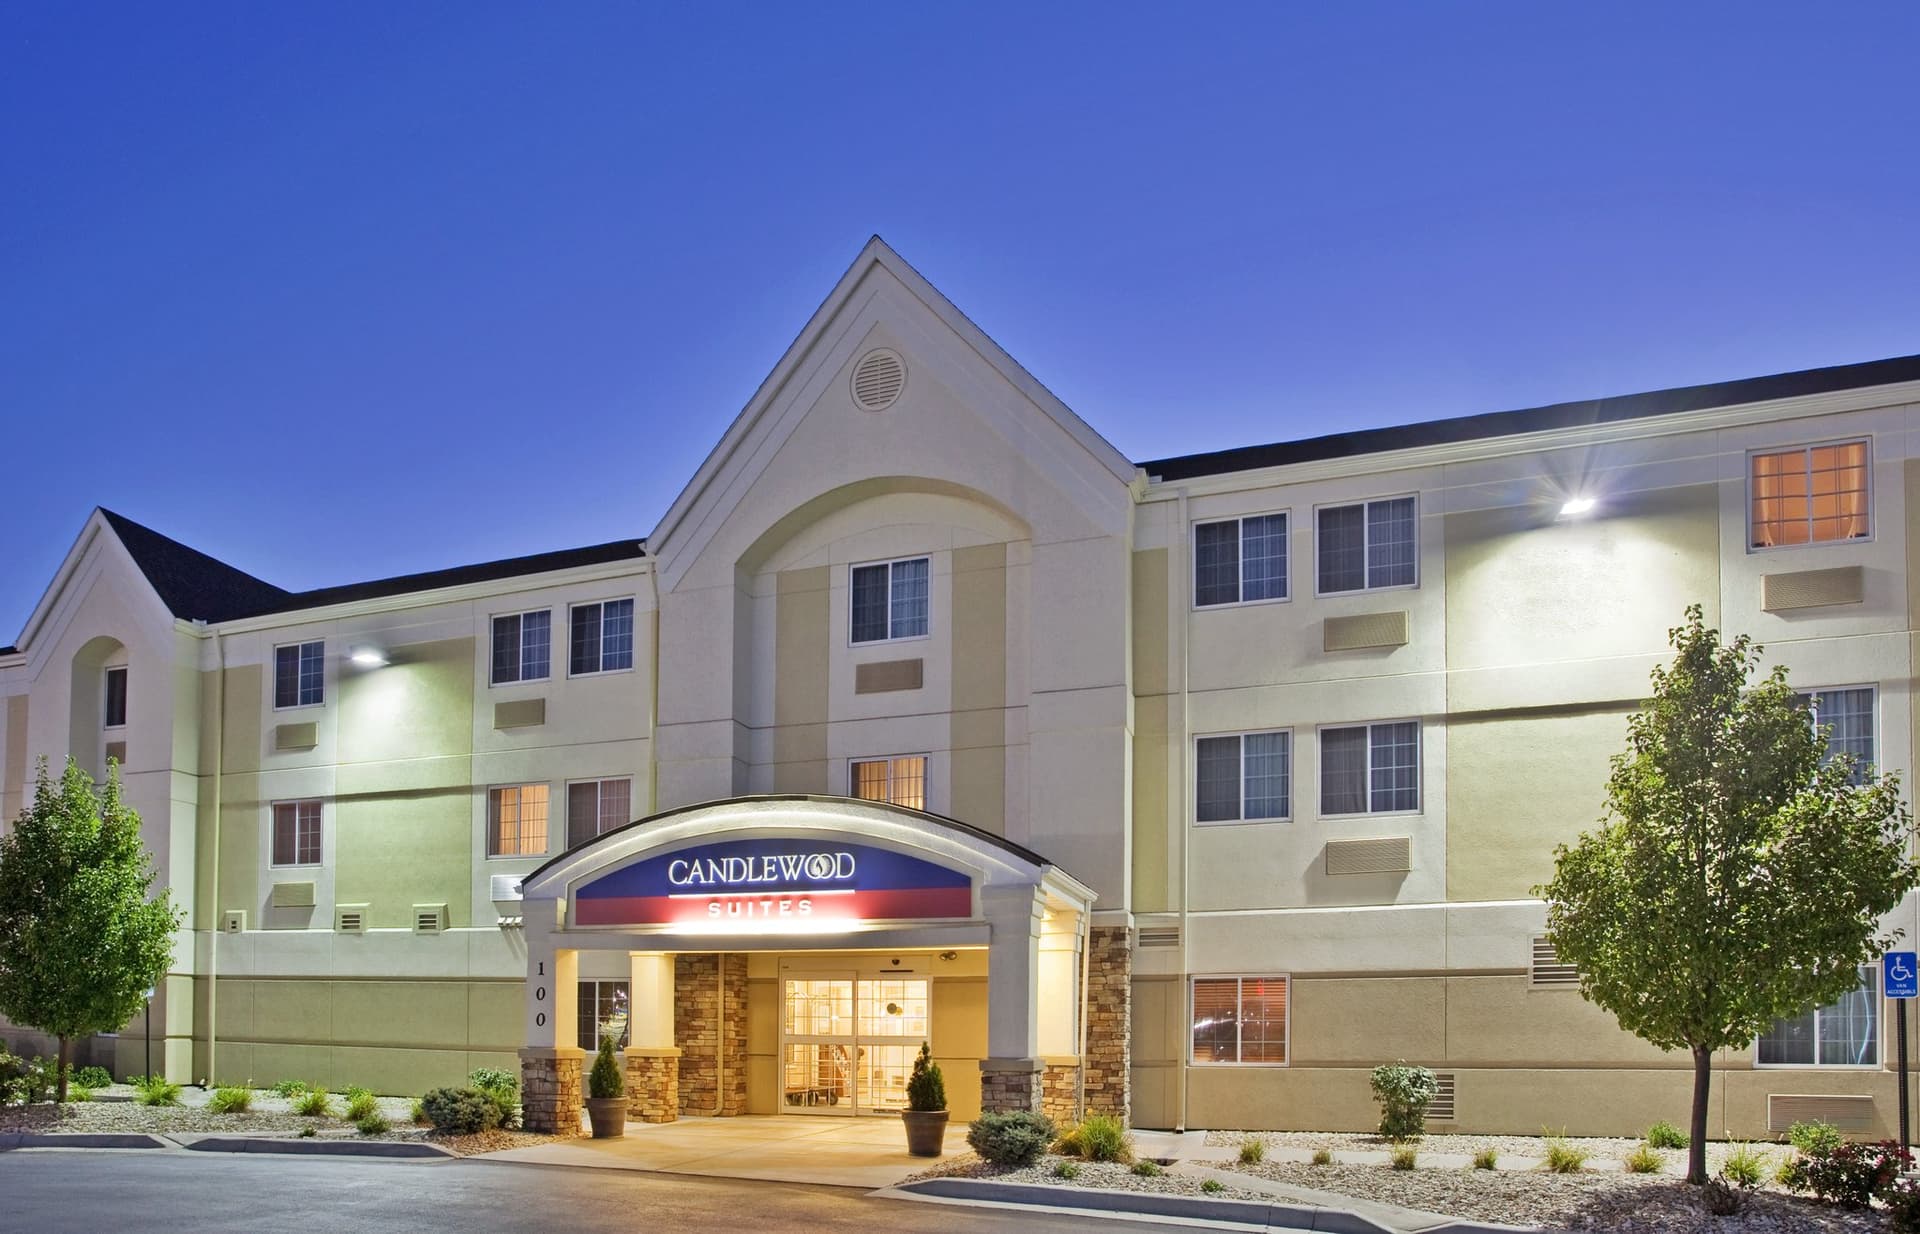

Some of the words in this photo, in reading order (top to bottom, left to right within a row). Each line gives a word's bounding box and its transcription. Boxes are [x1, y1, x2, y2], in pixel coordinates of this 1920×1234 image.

[668, 853, 855, 884] CANDLEWOOD
[708, 899, 812, 917] SUITES
[536, 962, 545, 1026] 100
